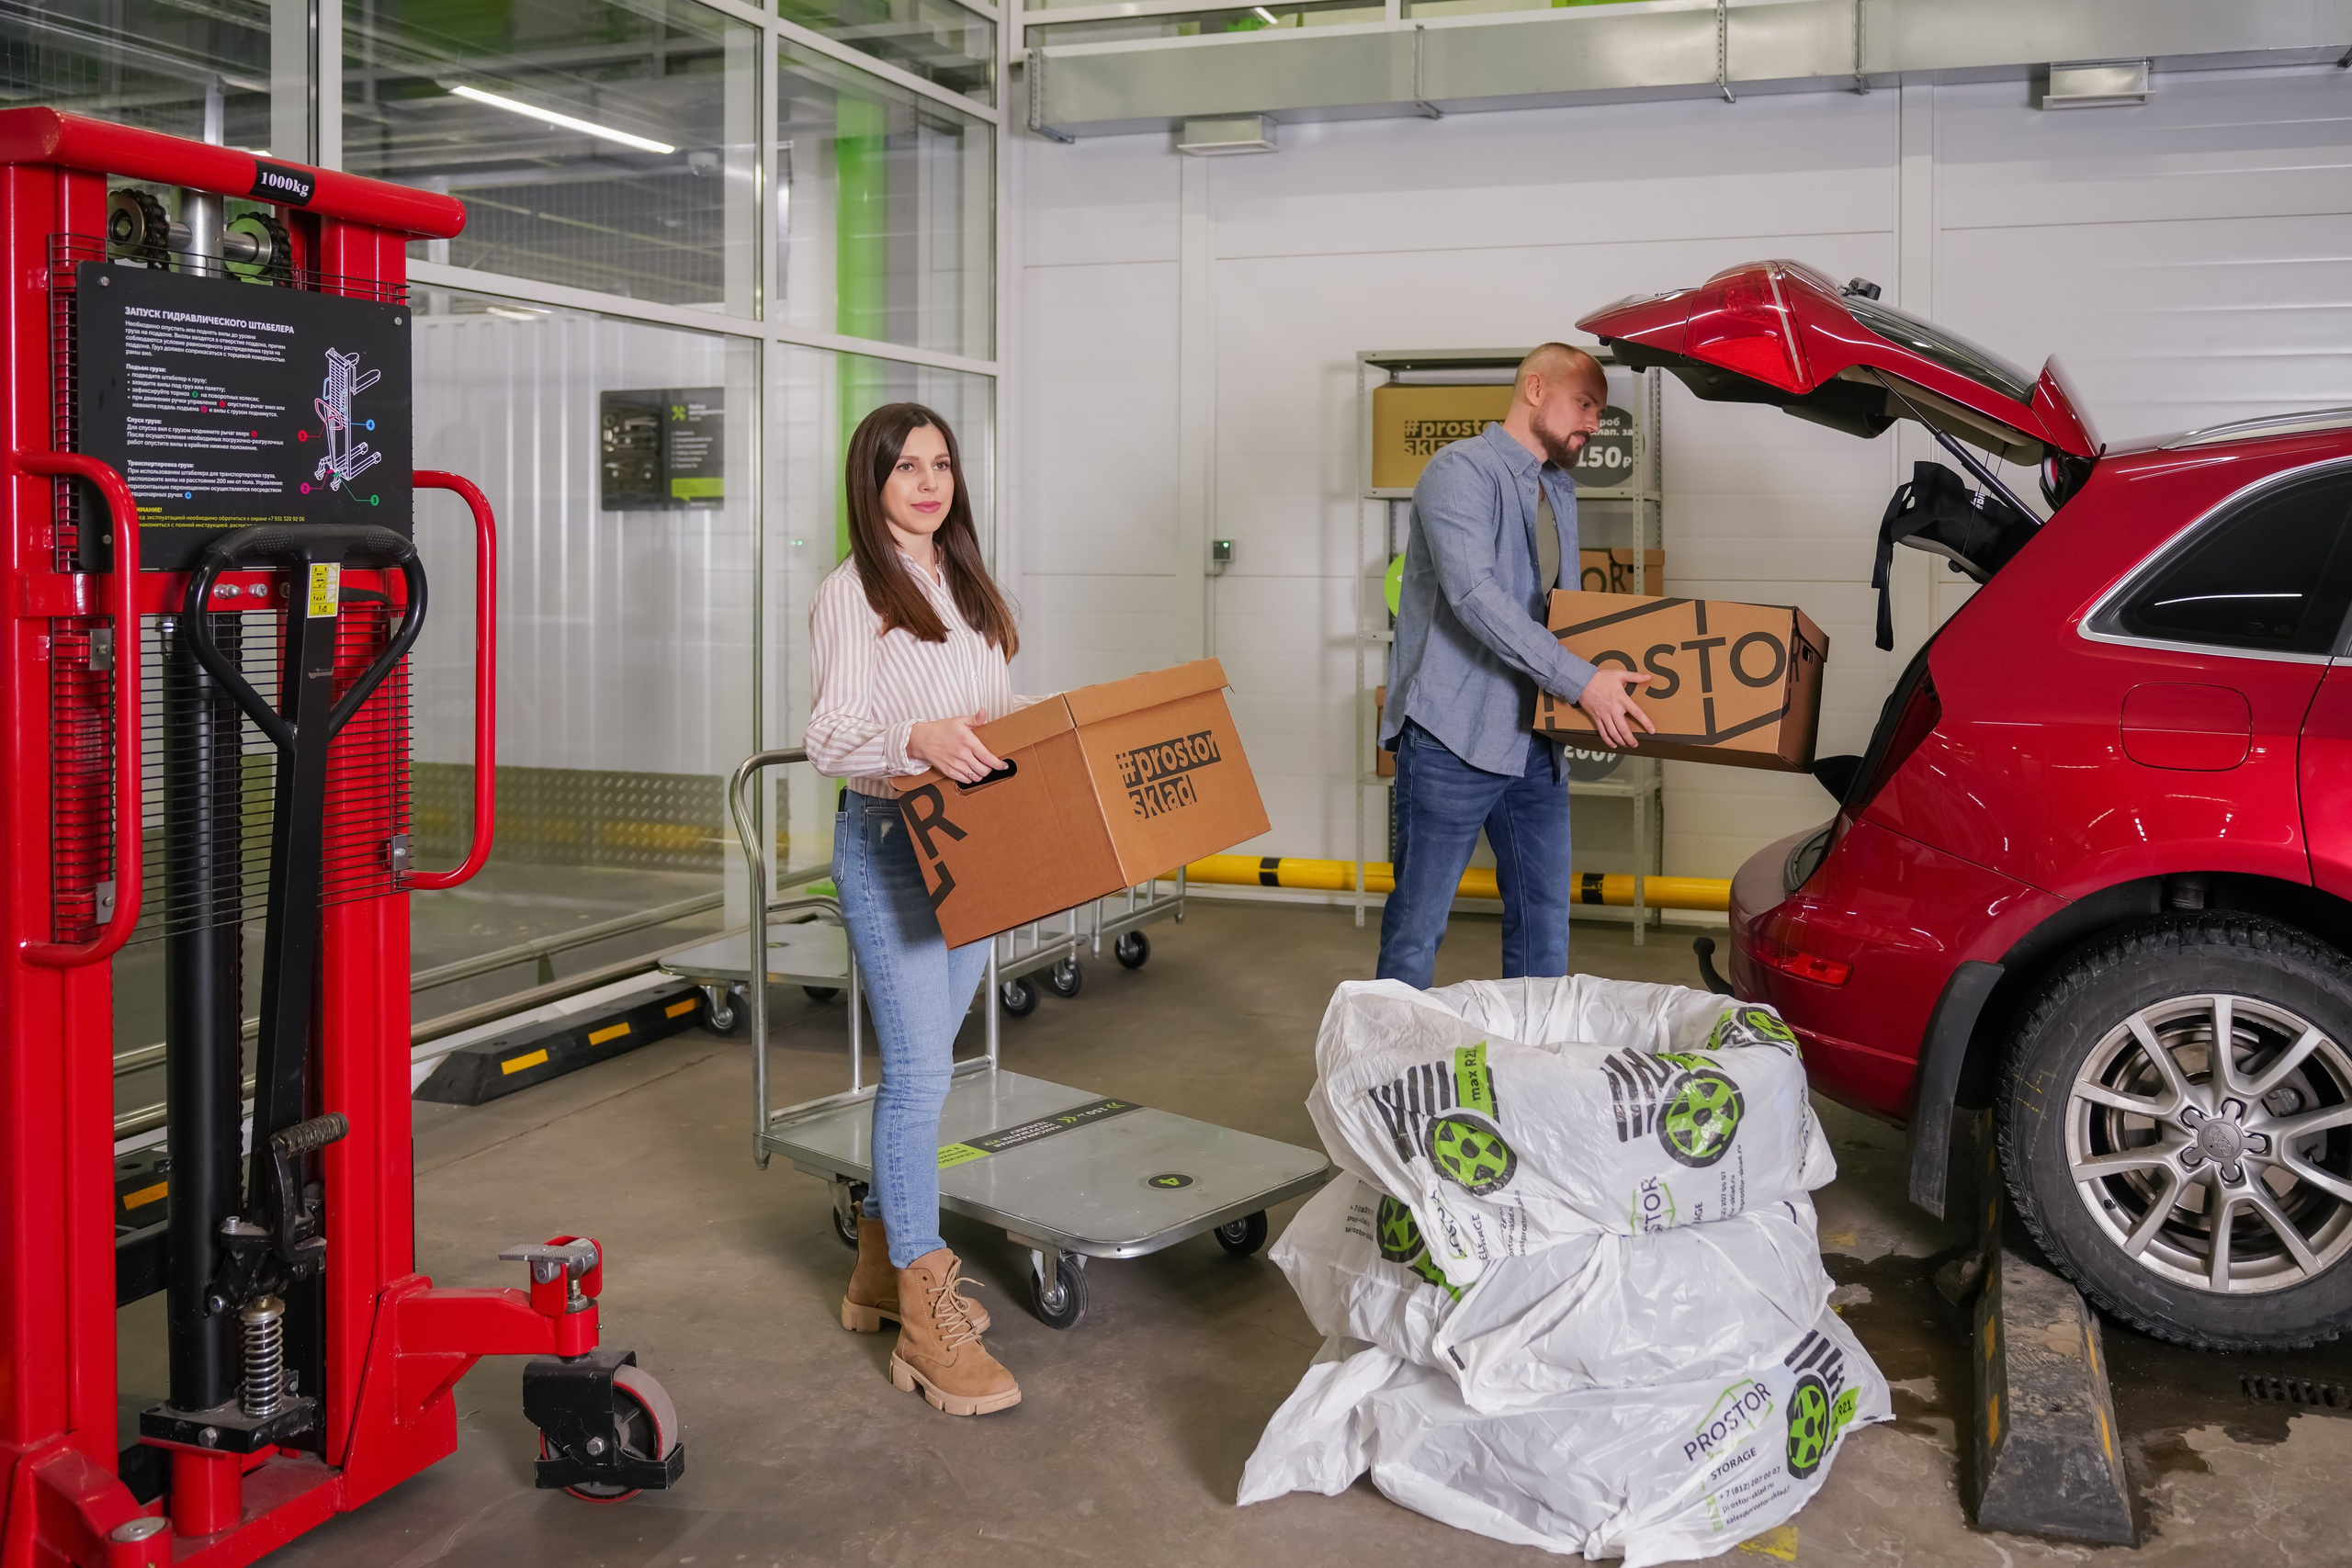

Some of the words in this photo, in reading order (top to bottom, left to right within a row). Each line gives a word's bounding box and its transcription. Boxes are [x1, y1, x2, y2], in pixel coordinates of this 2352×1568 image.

[260, 172, 310, 197] 1000kg
[124, 306, 161, 319] ЗАПУСК
[162, 310, 247, 329] ГИДРАВЛИЧЕСКОГО
[248, 321, 295, 334] ШТАБЕЛЕРА
[1405, 420, 1505, 438] #prost
[1600, 417, 1620, 428] роб
[1115, 731, 1221, 788] #prostor
[1129, 775, 1198, 821] sklad
[1468, 1070, 1481, 1101] max
[1085, 1107, 1108, 1115] 150
[1158, 1176, 1181, 1186] 4
[1683, 1382, 1772, 1461] PROSTOR
[1710, 1448, 1758, 1481] STORAGE
